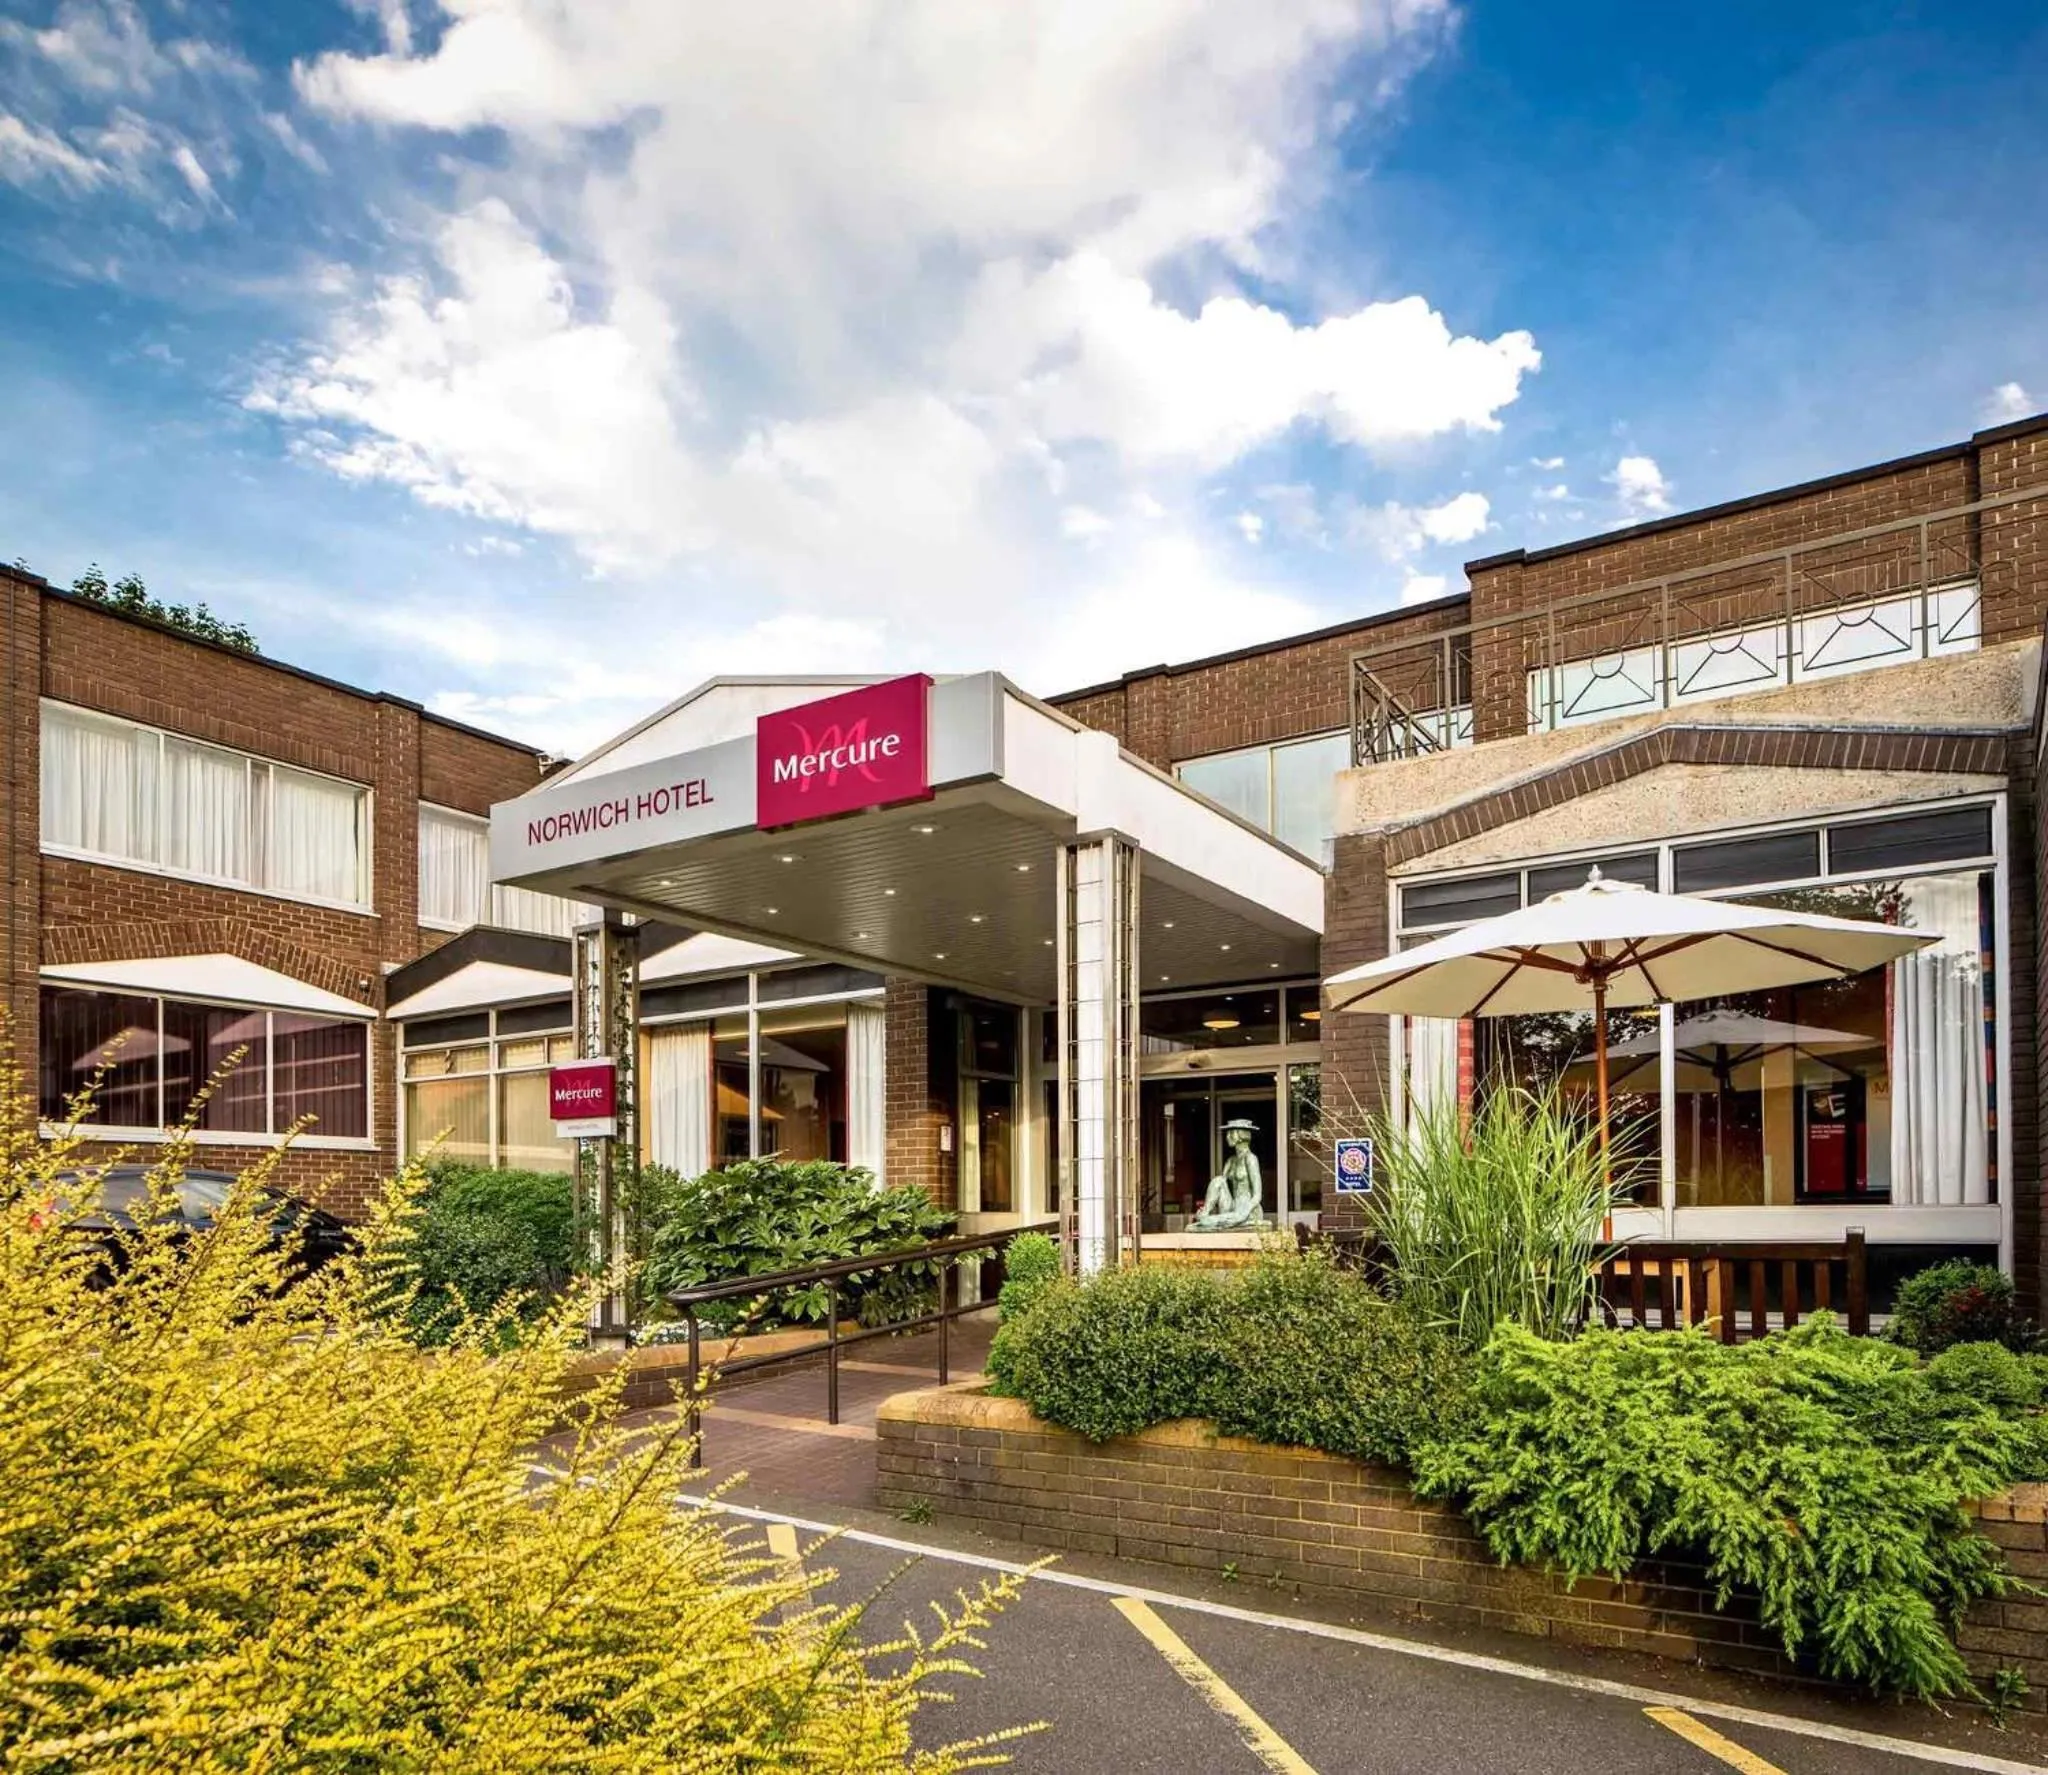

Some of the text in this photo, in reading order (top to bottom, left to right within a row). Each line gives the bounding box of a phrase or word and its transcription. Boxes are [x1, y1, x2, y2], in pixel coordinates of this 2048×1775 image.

[773, 731, 901, 783] Mercure
[528, 779, 714, 846] NORWICH HOTEL
[554, 1087, 603, 1102] Mercure
